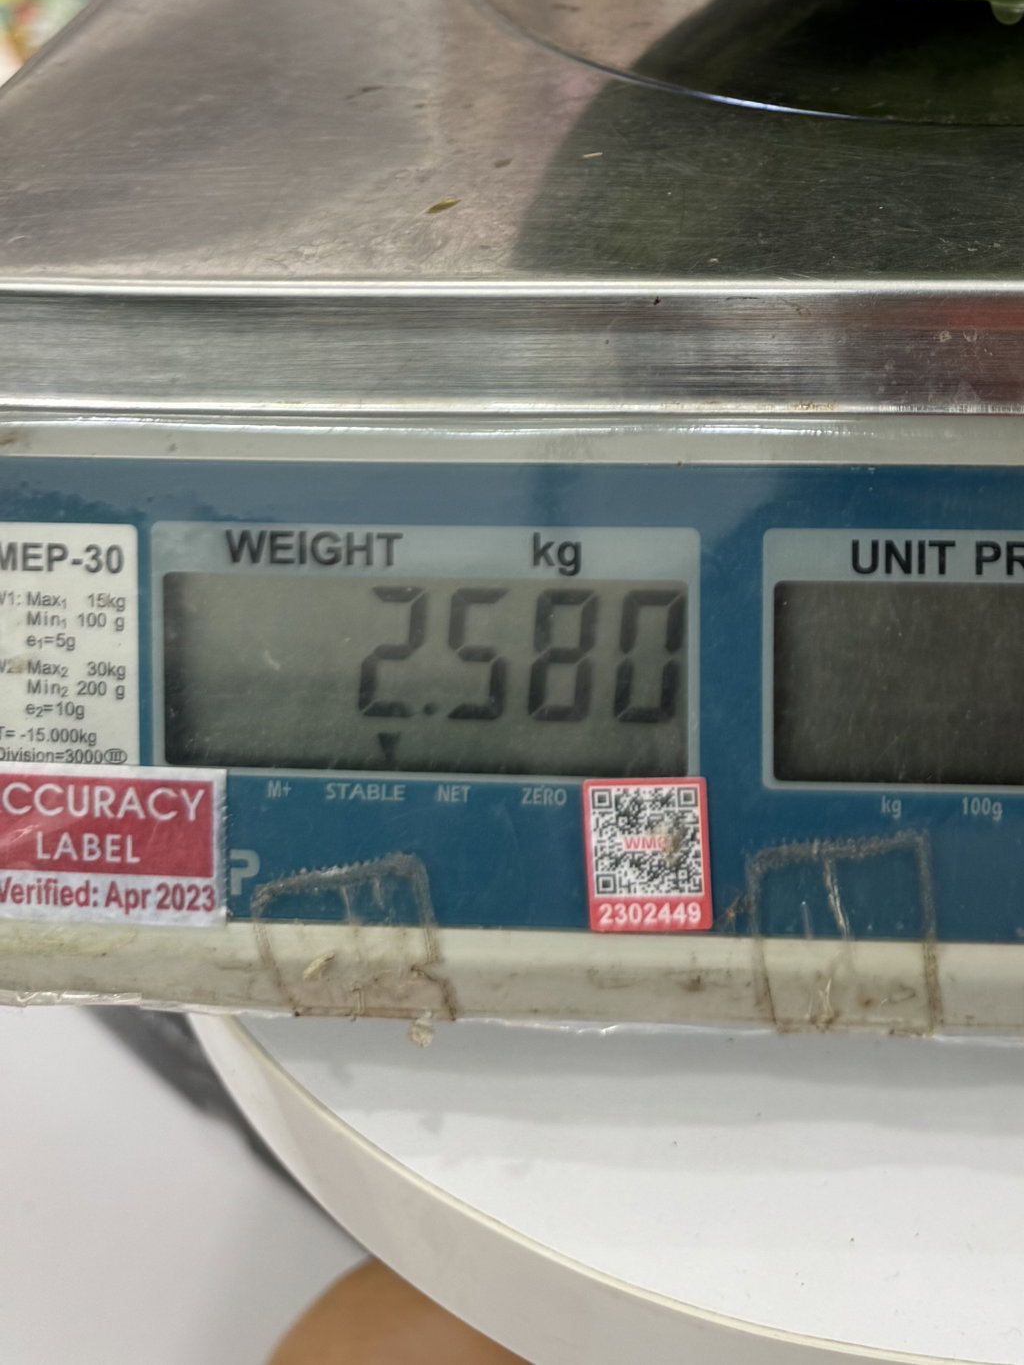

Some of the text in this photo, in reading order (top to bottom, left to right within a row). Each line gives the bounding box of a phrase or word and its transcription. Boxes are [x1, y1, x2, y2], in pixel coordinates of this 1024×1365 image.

[0, 541, 125, 574] MEP-30
[224, 530, 582, 576] WEIGHT kg
[851, 539, 956, 576] UNIT
[87, 593, 126, 612] 15kg
[76, 612, 107, 628] 100
[114, 616, 126, 632] g
[357, 585, 688, 723] 2.580
[87, 661, 127, 681] 30kg
[76, 680, 107, 697] 200
[115, 684, 126, 700] g
[0, 781, 206, 822] CCURACY
[325, 781, 405, 803] STABLE
[437, 783, 471, 804] NET
[521, 785, 567, 807] ZERO
[881, 794, 902, 819] kg
[962, 796, 1003, 822] 100g
[36, 830, 141, 864] LABEL
[0, 876, 216, 915] Verified: Apr 2023
[598, 901, 702, 925] 2302449
